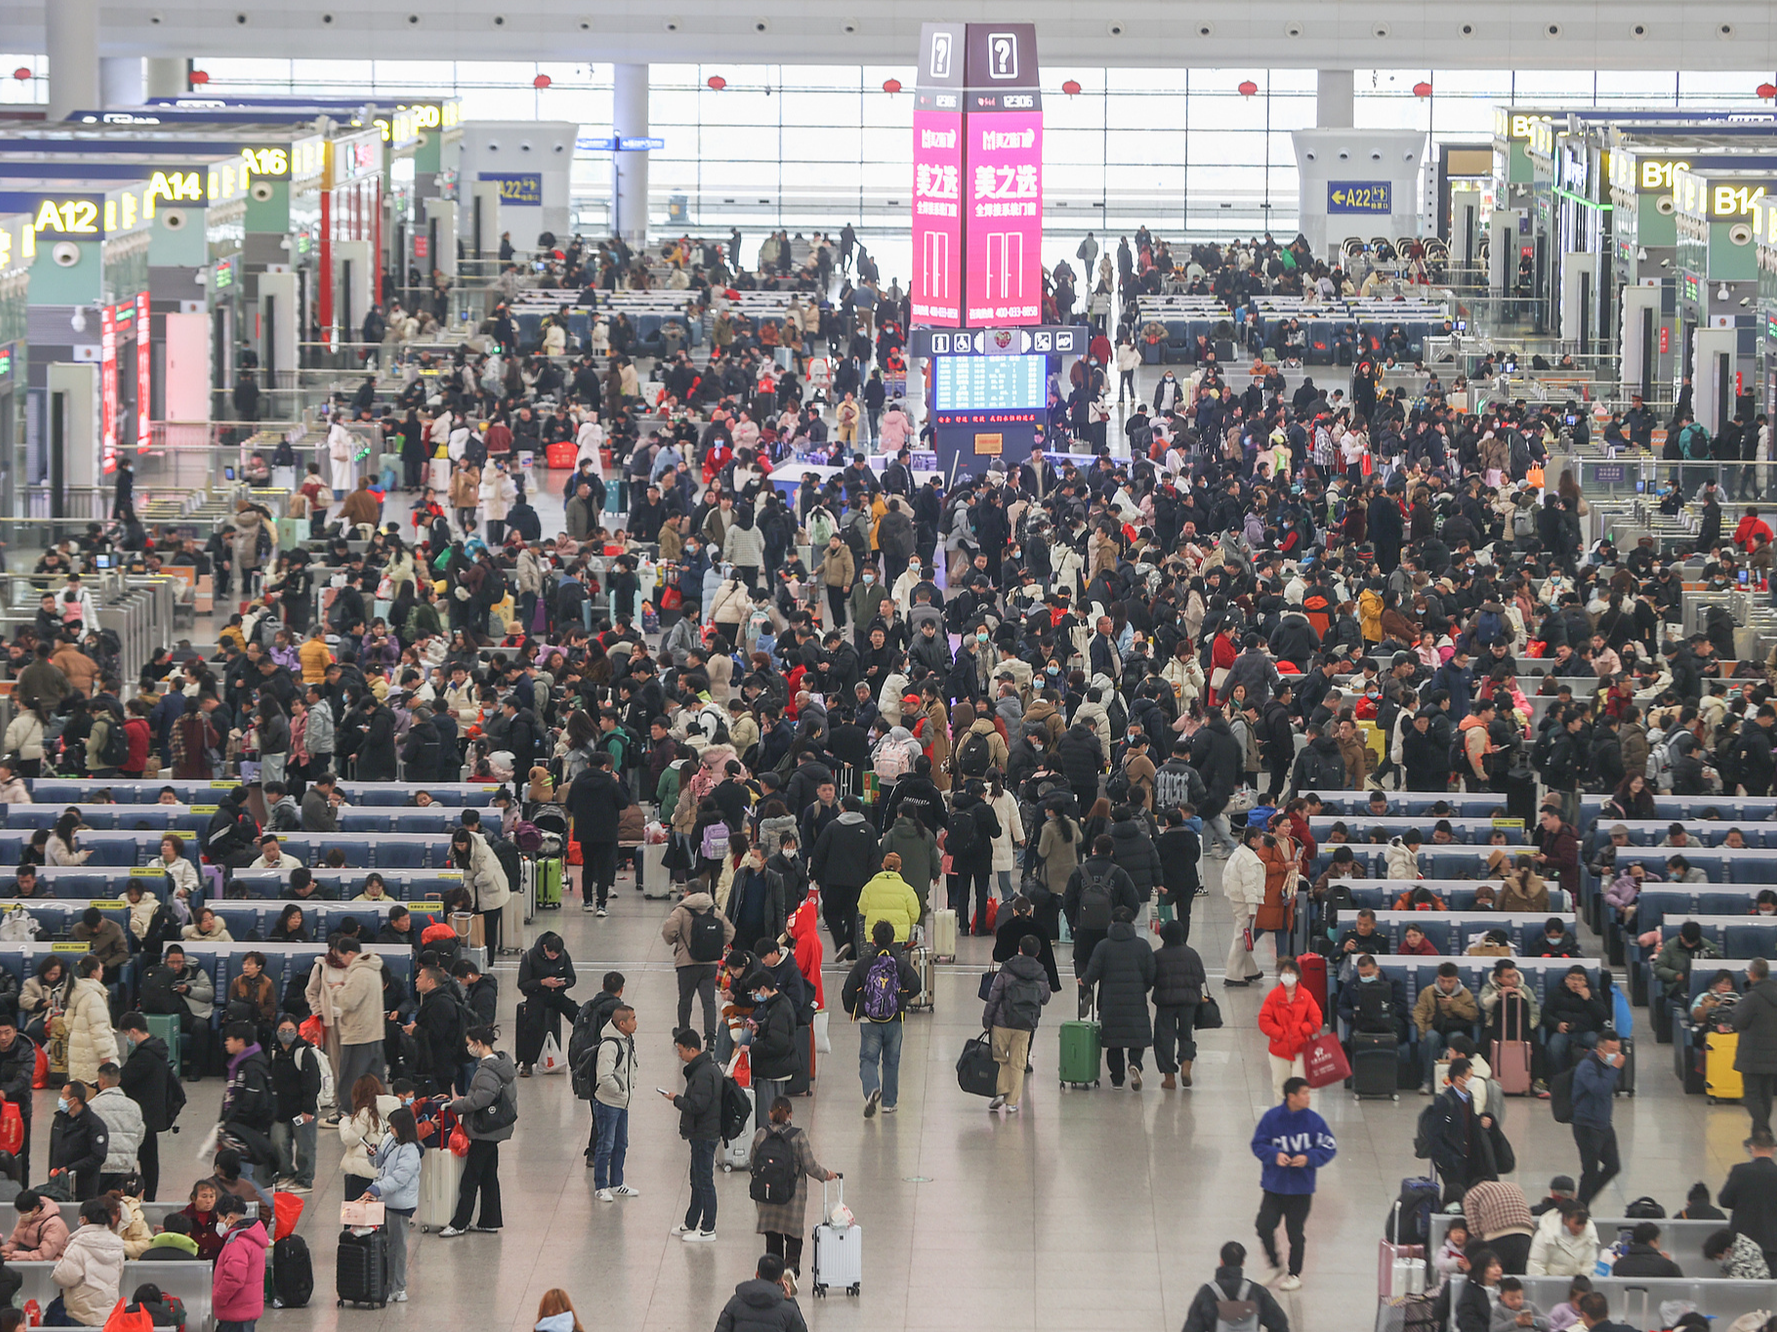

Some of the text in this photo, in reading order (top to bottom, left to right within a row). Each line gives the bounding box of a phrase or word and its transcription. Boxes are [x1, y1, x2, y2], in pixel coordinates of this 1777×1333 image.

[1003, 95, 1034, 108] 12306
[241, 148, 288, 175] A16
[149, 172, 203, 201] A14
[916, 163, 958, 199] 美之选
[974, 164, 1038, 200] 美之选
[1346, 188, 1371, 207] A22
[34, 200, 98, 233] A12
